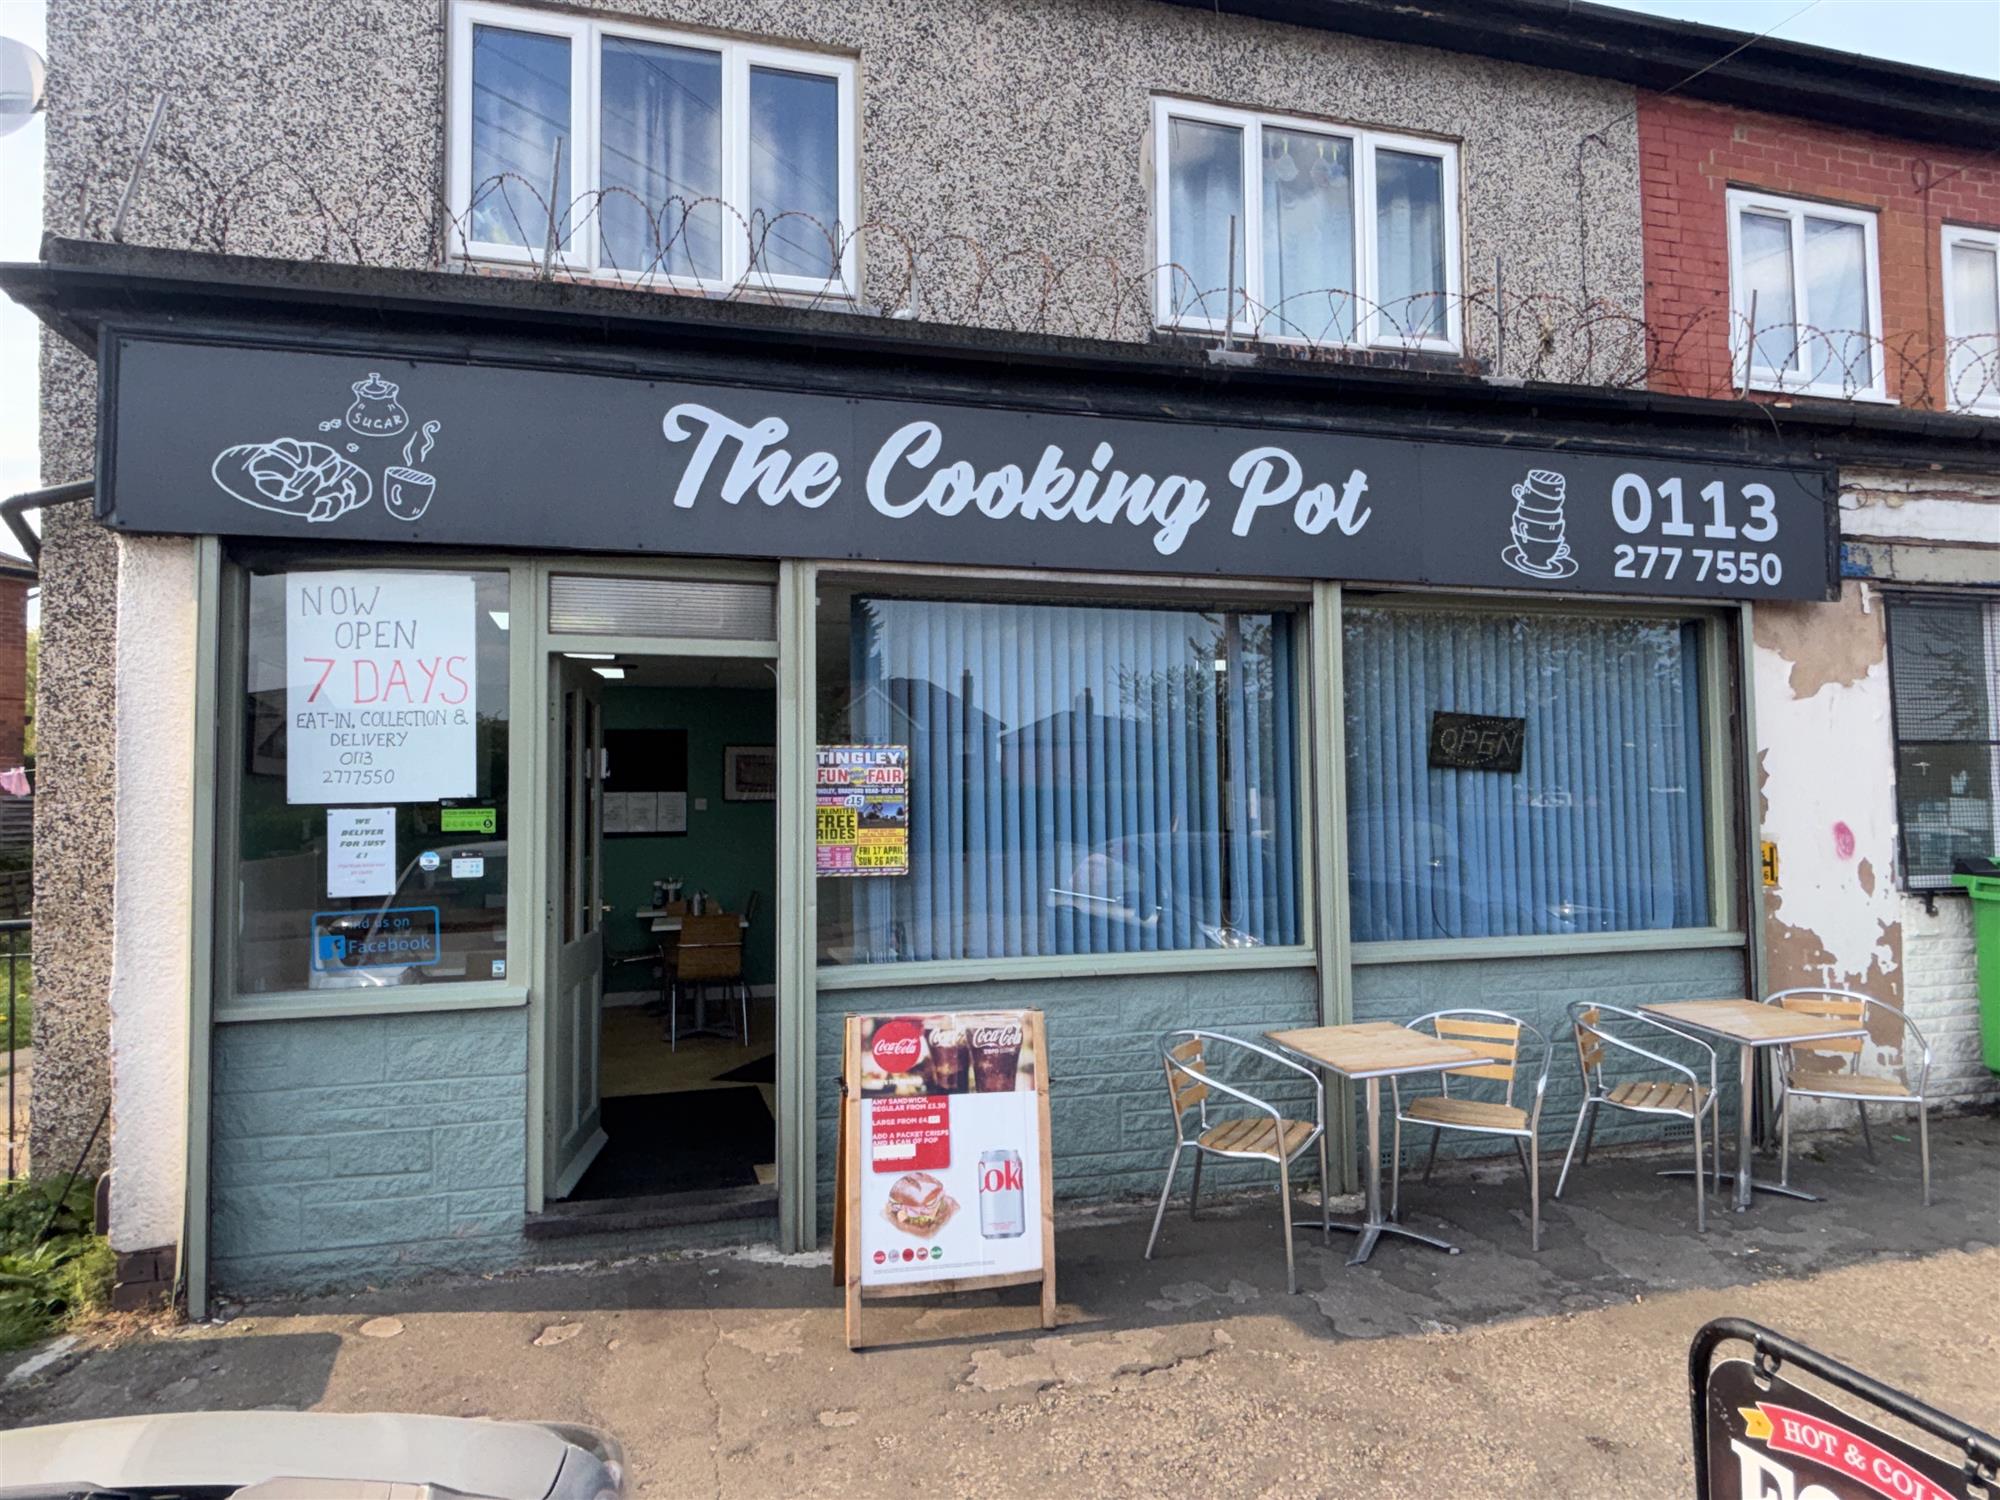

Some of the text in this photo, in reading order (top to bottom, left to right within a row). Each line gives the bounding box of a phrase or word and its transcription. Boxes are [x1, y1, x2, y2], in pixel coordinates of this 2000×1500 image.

[352, 412, 403, 429] SUGAR
[662, 402, 1372, 556] The Cooking Pot
[1611, 473, 1779, 542] 0113
[1613, 543, 1783, 586] 277 7550
[301, 586, 380, 617] NOW
[335, 619, 417, 650] OPEN
[303, 655, 468, 705] 7 DAYS
[360, 709, 447, 728] COLLECTION
[453, 708, 469, 726] &
[330, 731, 409, 748] DELIVERY
[1440, 728, 1520, 758] OPEN
[816, 751, 900, 765] TINGLEY
[322, 769, 395, 786] 2777550
[817, 768, 849, 783] FUN
[867, 768, 902, 783] FAIR
[816, 815, 855, 828] FREE
[341, 829, 384, 837] DELIVER
[816, 828, 855, 840] RIDES
[859, 847, 871, 855] FRI
[883, 847, 904, 855] APRIL
[393, 917, 410, 929] on
[349, 935, 431, 954] Facebook
[872, 1118, 896, 1126] LARGE
[896, 1117, 917, 1125] FROM
[924, 1129, 949, 1137] CRISPS
[924, 1136, 939, 1144] POP
[1781, 1417, 1838, 1457] HOT
[1843, 1443, 1867, 1472] &
